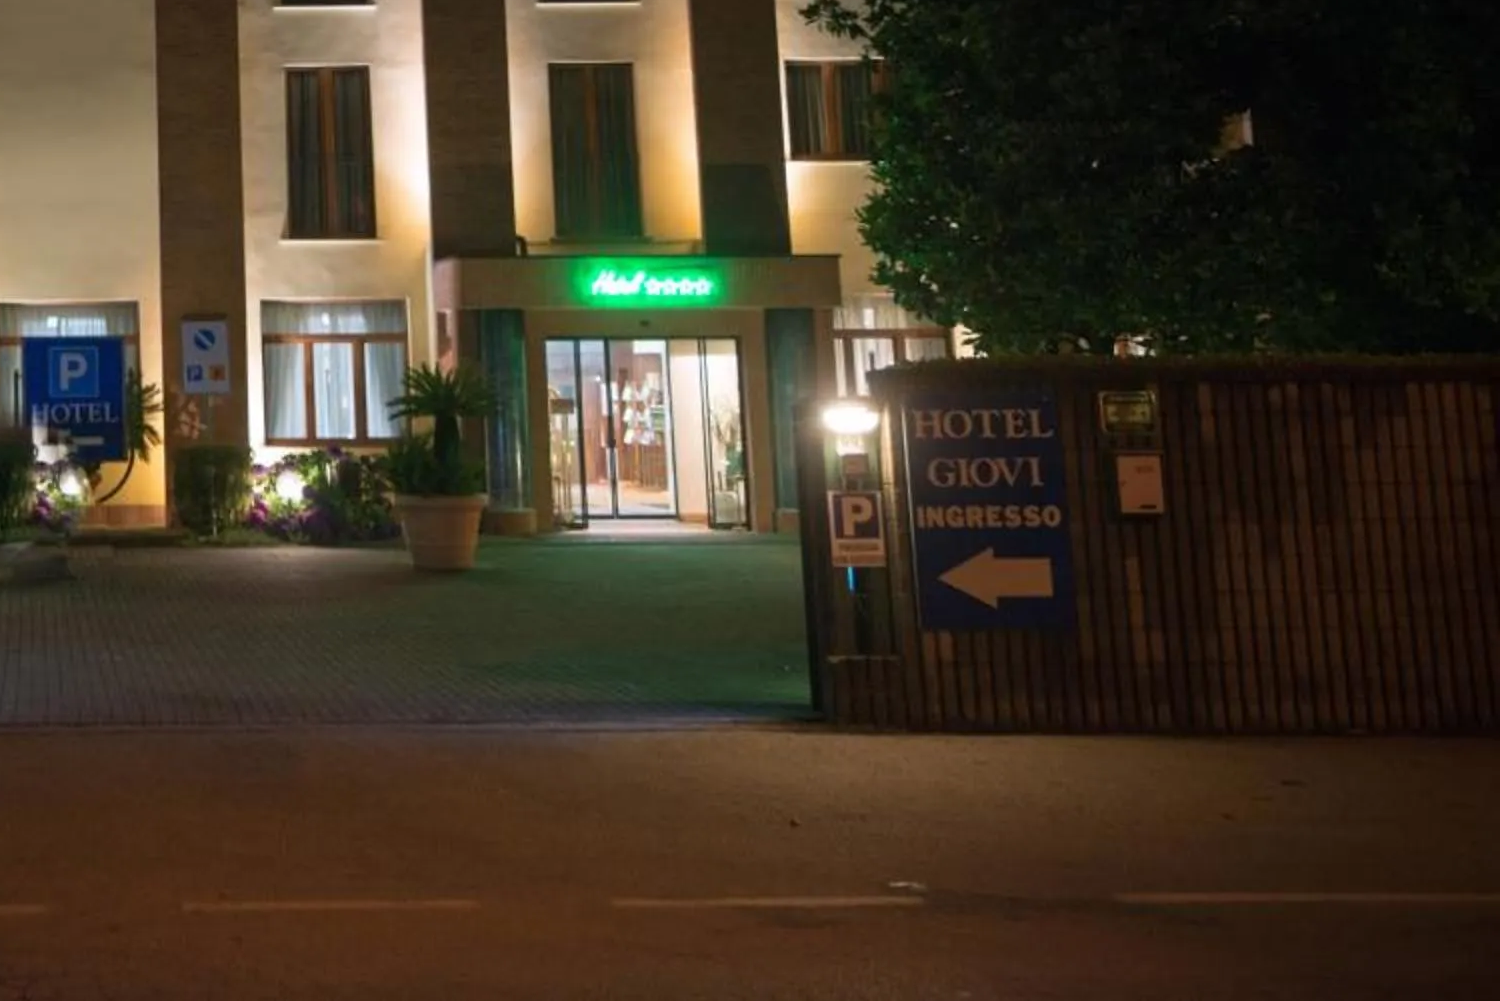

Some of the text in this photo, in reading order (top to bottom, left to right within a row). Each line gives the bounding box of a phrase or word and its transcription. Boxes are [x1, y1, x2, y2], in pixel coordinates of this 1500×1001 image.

[59, 352, 88, 392] P
[31, 402, 120, 425] HOTEL
[912, 407, 1055, 440] HOTEL
[927, 456, 1045, 489] GIOVI
[842, 496, 872, 536] P
[916, 504, 1062, 530] INGRESSO
